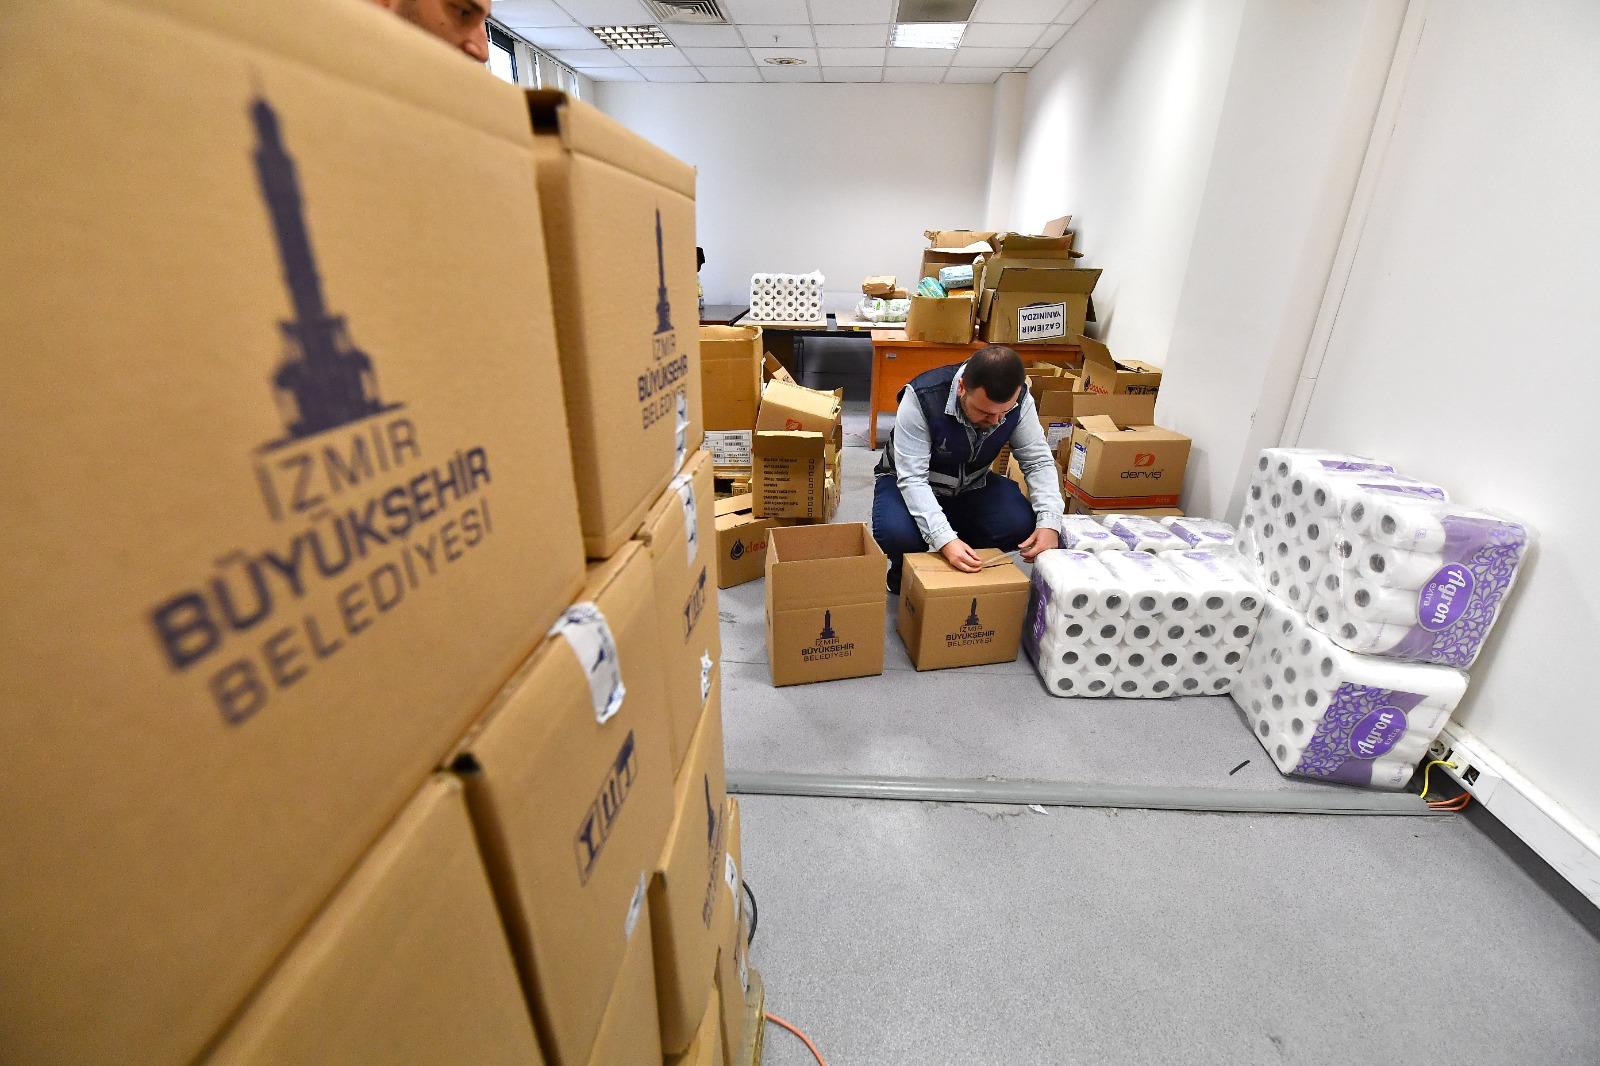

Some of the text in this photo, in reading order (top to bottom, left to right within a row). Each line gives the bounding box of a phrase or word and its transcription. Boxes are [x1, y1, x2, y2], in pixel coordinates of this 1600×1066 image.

[1021, 310, 1061, 321] YANINIZDA
[1022, 322, 1061, 334] GAZİEMİR
[253, 417, 422, 522] İZMİR
[1120, 468, 1162, 480] derviş
[1431, 570, 1466, 624] Agron
[1357, 712, 1394, 755] Agron
